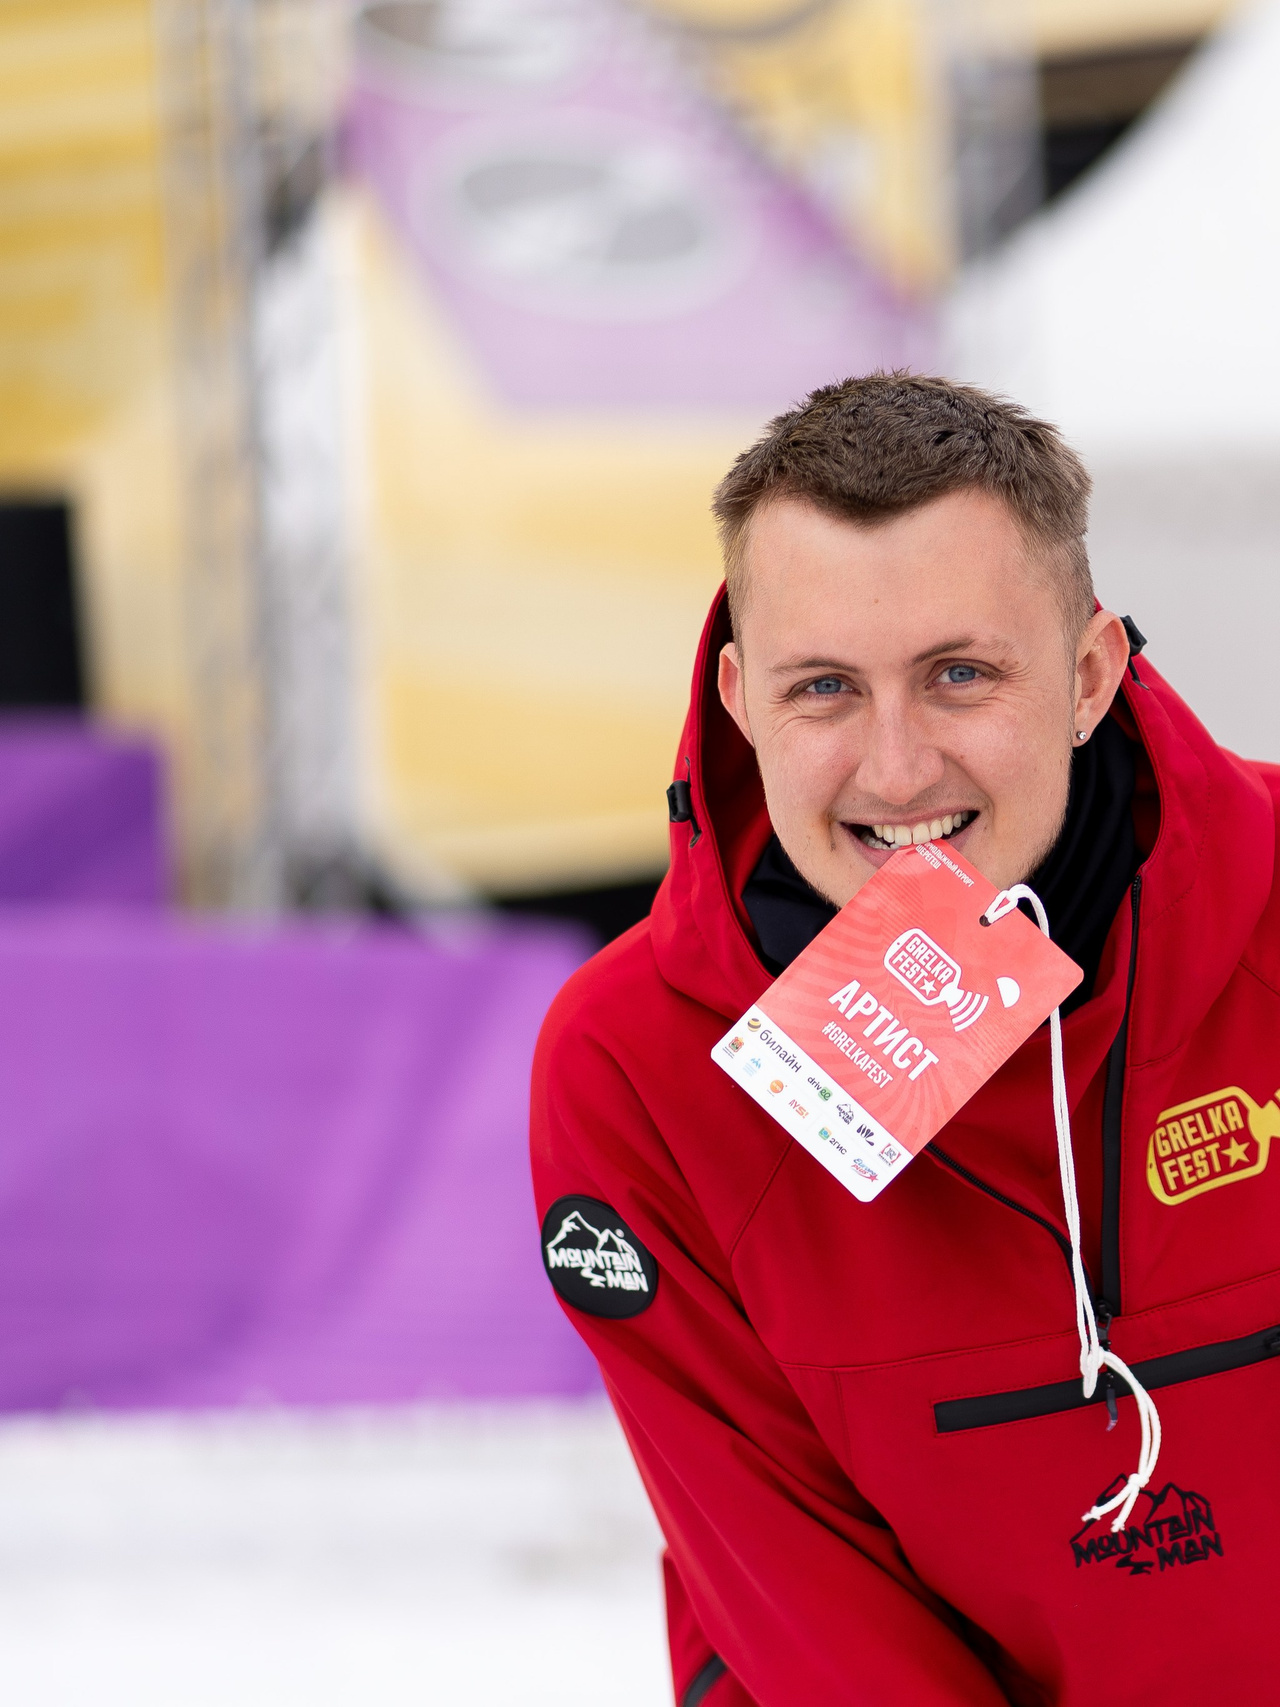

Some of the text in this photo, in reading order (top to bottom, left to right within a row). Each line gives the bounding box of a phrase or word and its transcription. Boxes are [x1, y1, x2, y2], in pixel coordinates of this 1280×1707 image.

[915, 844, 942, 870] ШЕРЕГЕШ
[924, 841, 974, 887] РНОЛЫЖНЫЙ КУРОРТ
[892, 950, 928, 984] FEST
[905, 936, 954, 984] GRELKA
[759, 1029, 802, 1073] билайн
[828, 979, 940, 1081] АРТИСТ
[821, 1021, 893, 1089] #GRELKAFEST
[807, 1076, 832, 1101] drivee
[829, 1137, 847, 1155] 2ГИС
[1155, 1100, 1245, 1158] GRELKA
[1161, 1142, 1222, 1191] FEST
[547, 1247, 643, 1273] MOUNTAIN
[605, 1269, 649, 1292] MAN
[1071, 1507, 1215, 1568] MOUNTAIN
[1156, 1531, 1224, 1572] MAN
